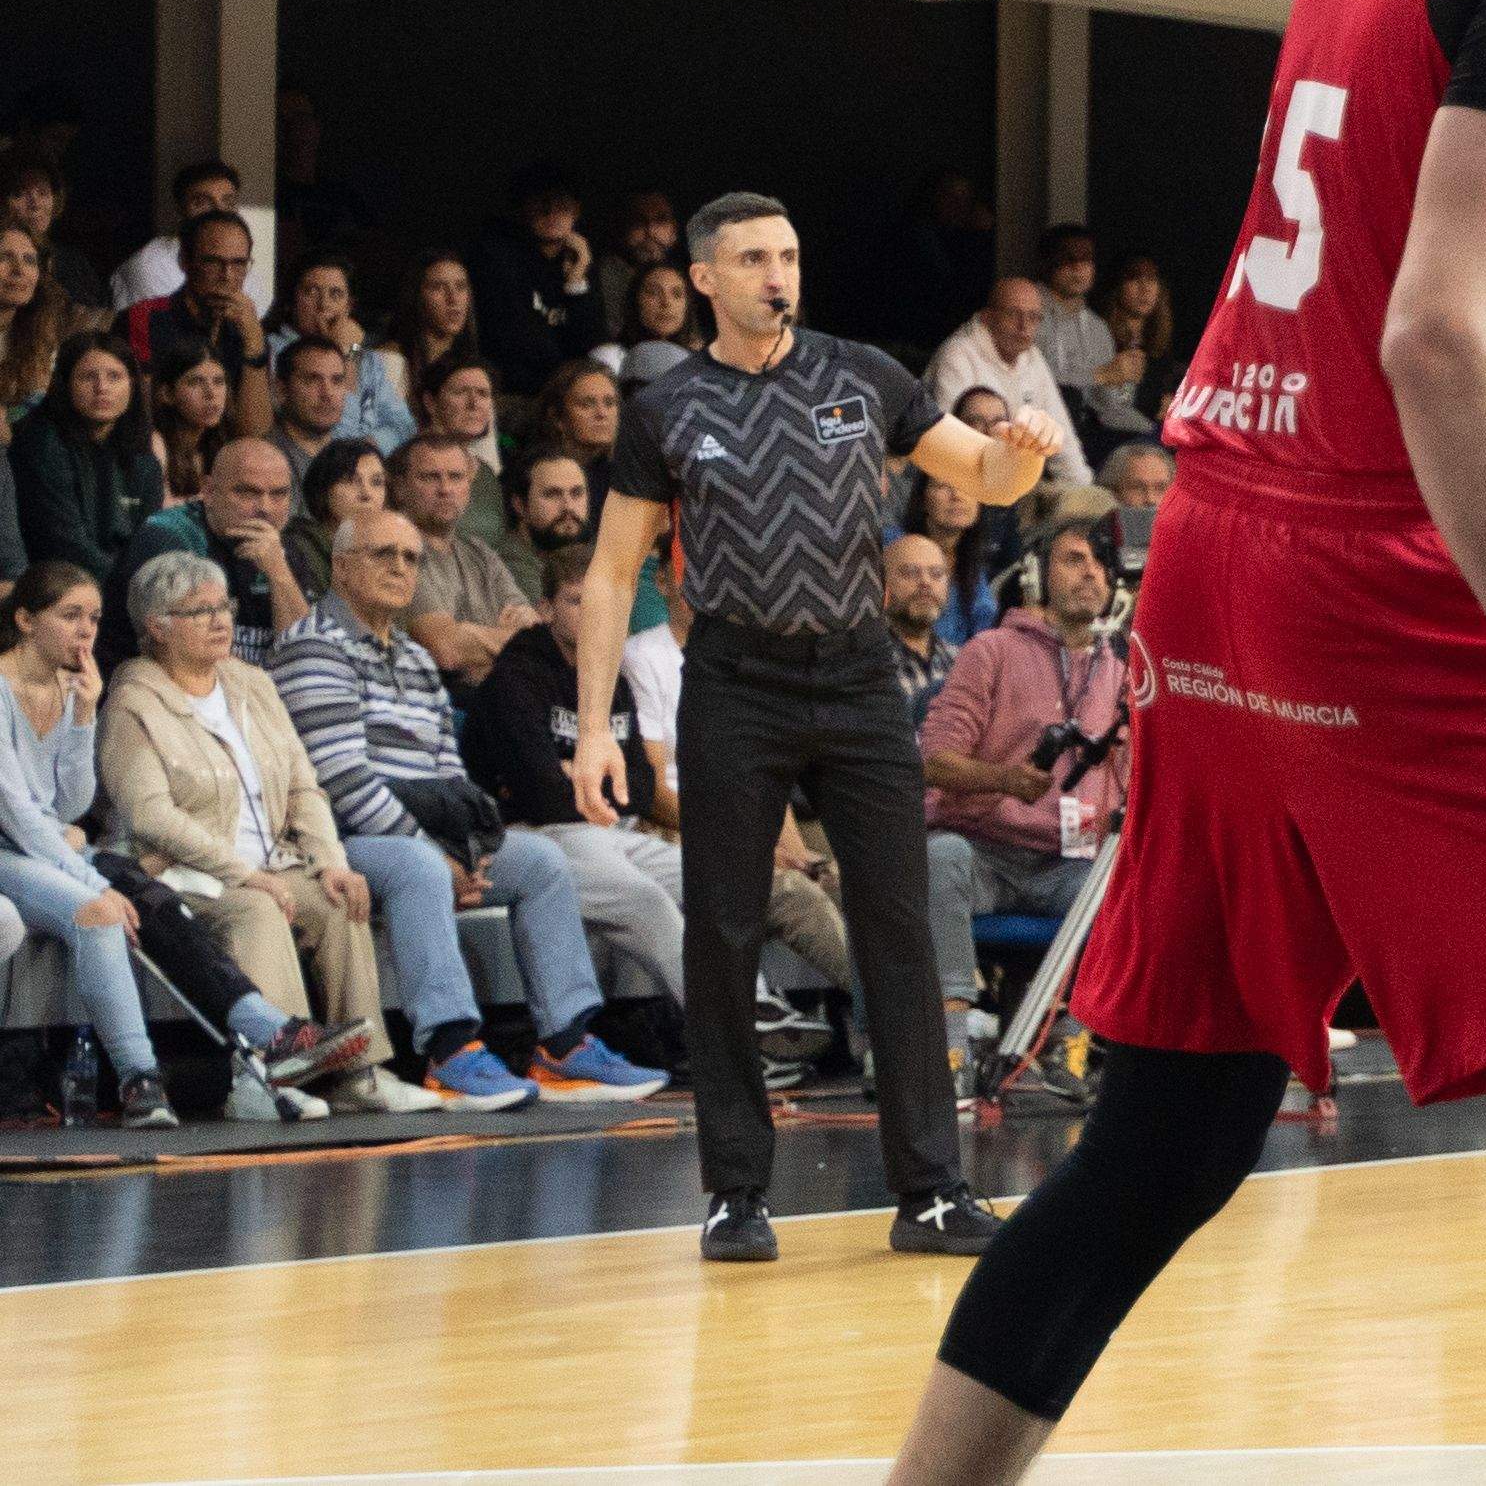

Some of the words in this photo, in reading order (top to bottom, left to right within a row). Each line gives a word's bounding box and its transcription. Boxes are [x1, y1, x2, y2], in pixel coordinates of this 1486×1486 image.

[1226, 80, 1349, 312] 5
[1166, 672, 1244, 708] REGIÓN
[1247, 691, 1272, 713] DE
[1272, 698, 1360, 727] MURCIA
